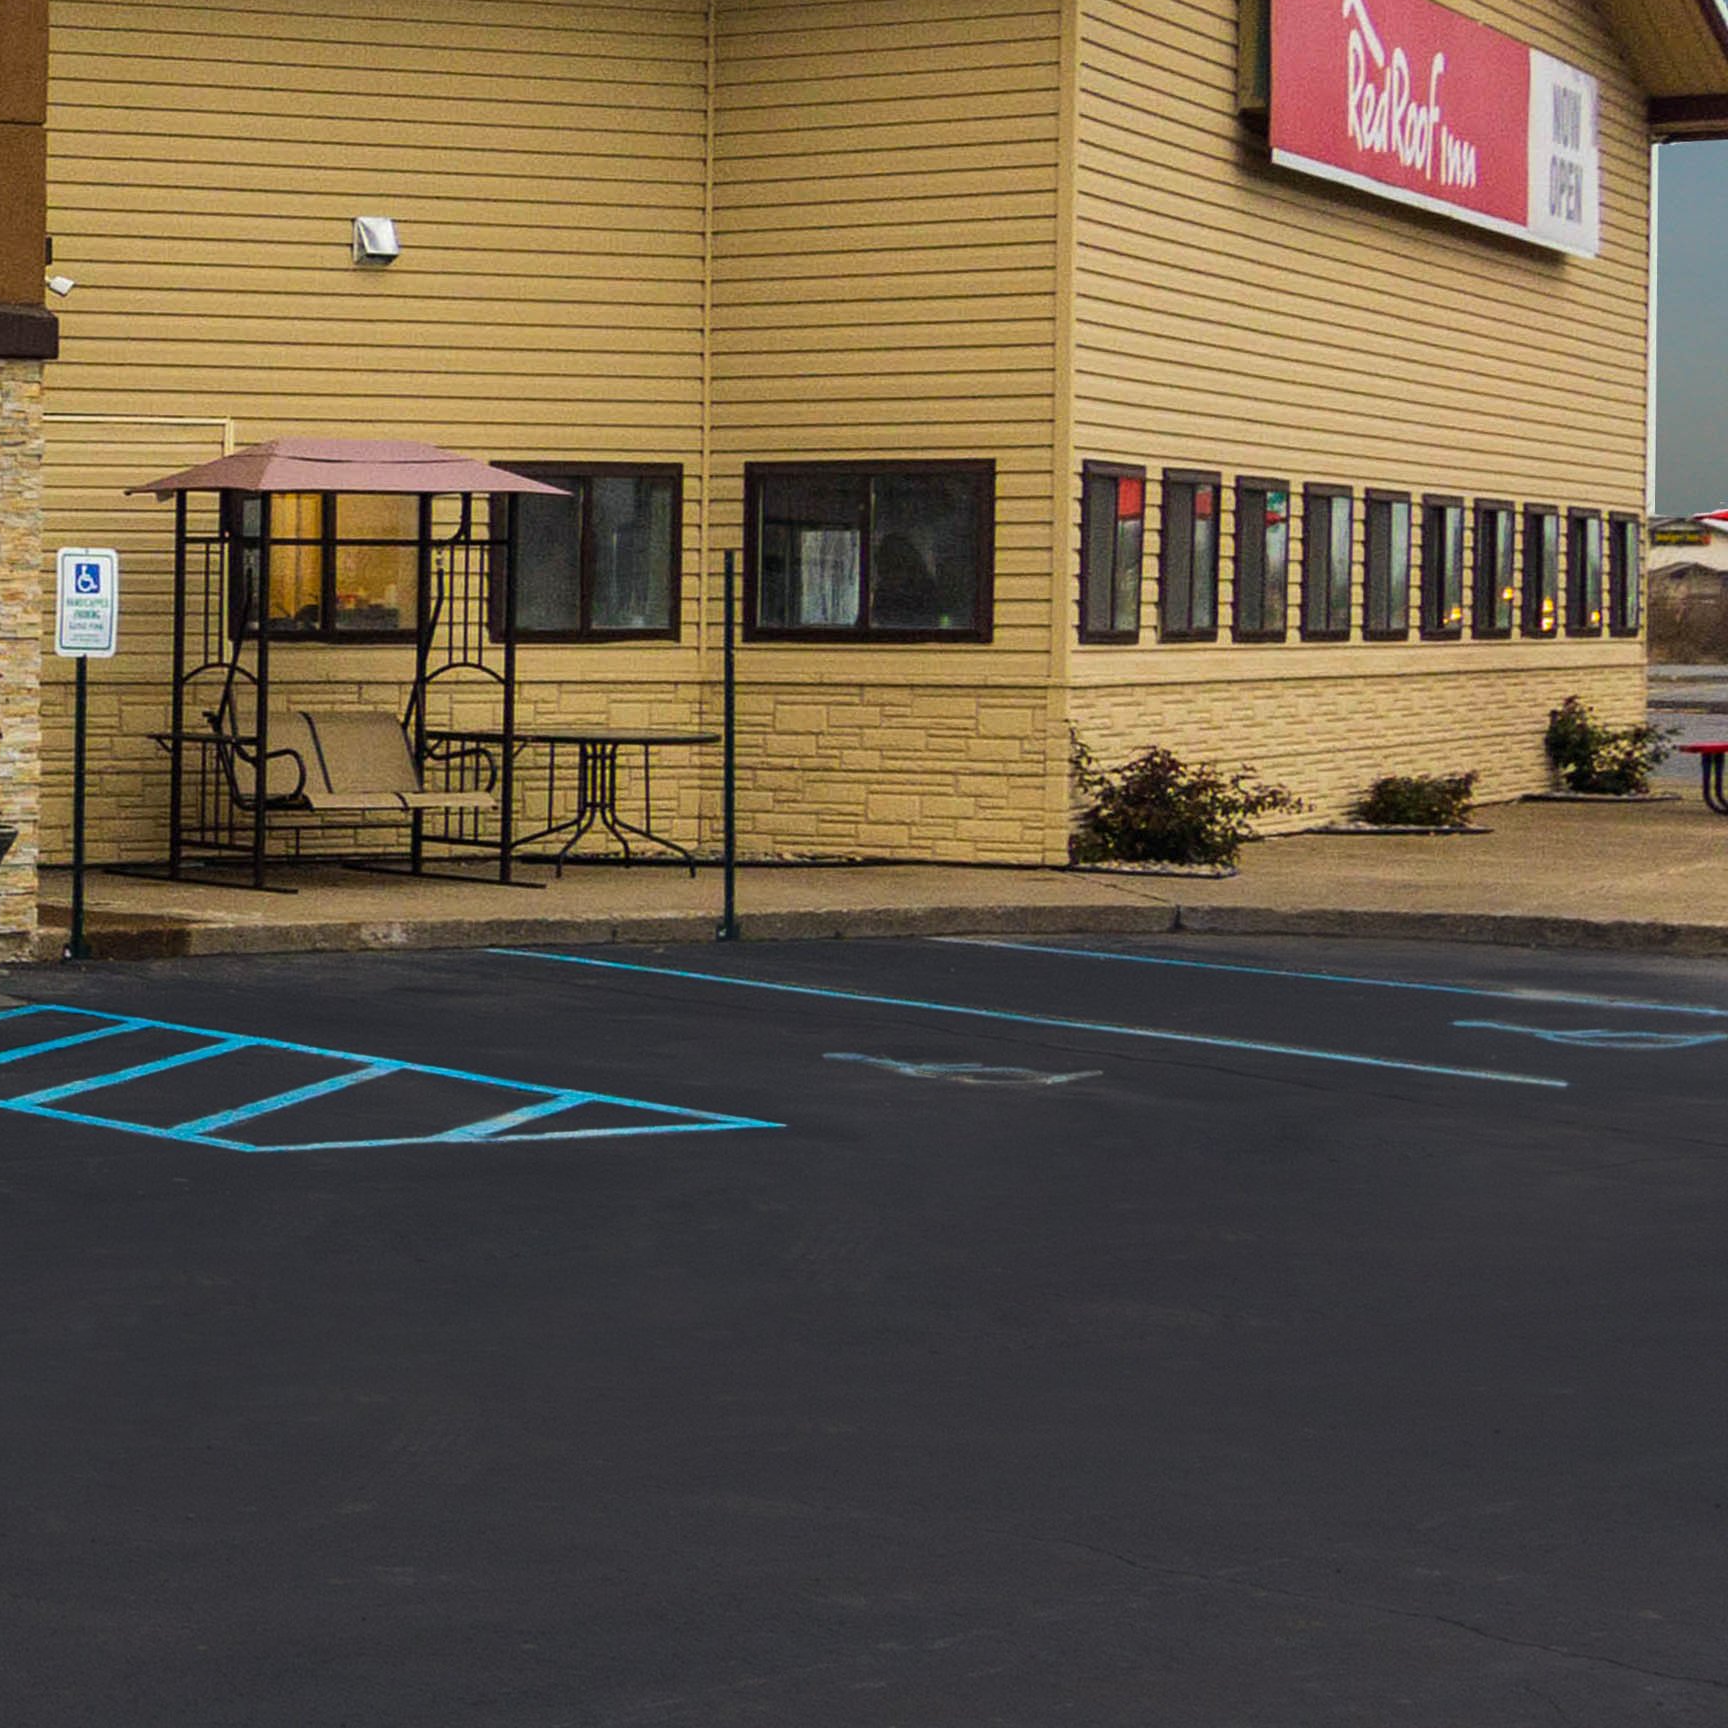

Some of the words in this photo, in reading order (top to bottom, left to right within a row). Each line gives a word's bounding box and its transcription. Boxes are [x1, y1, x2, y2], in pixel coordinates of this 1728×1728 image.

[1347, 28, 1391, 152] Red
[1392, 47, 1445, 181] Roof
[1549, 153, 1583, 225] OPEN
